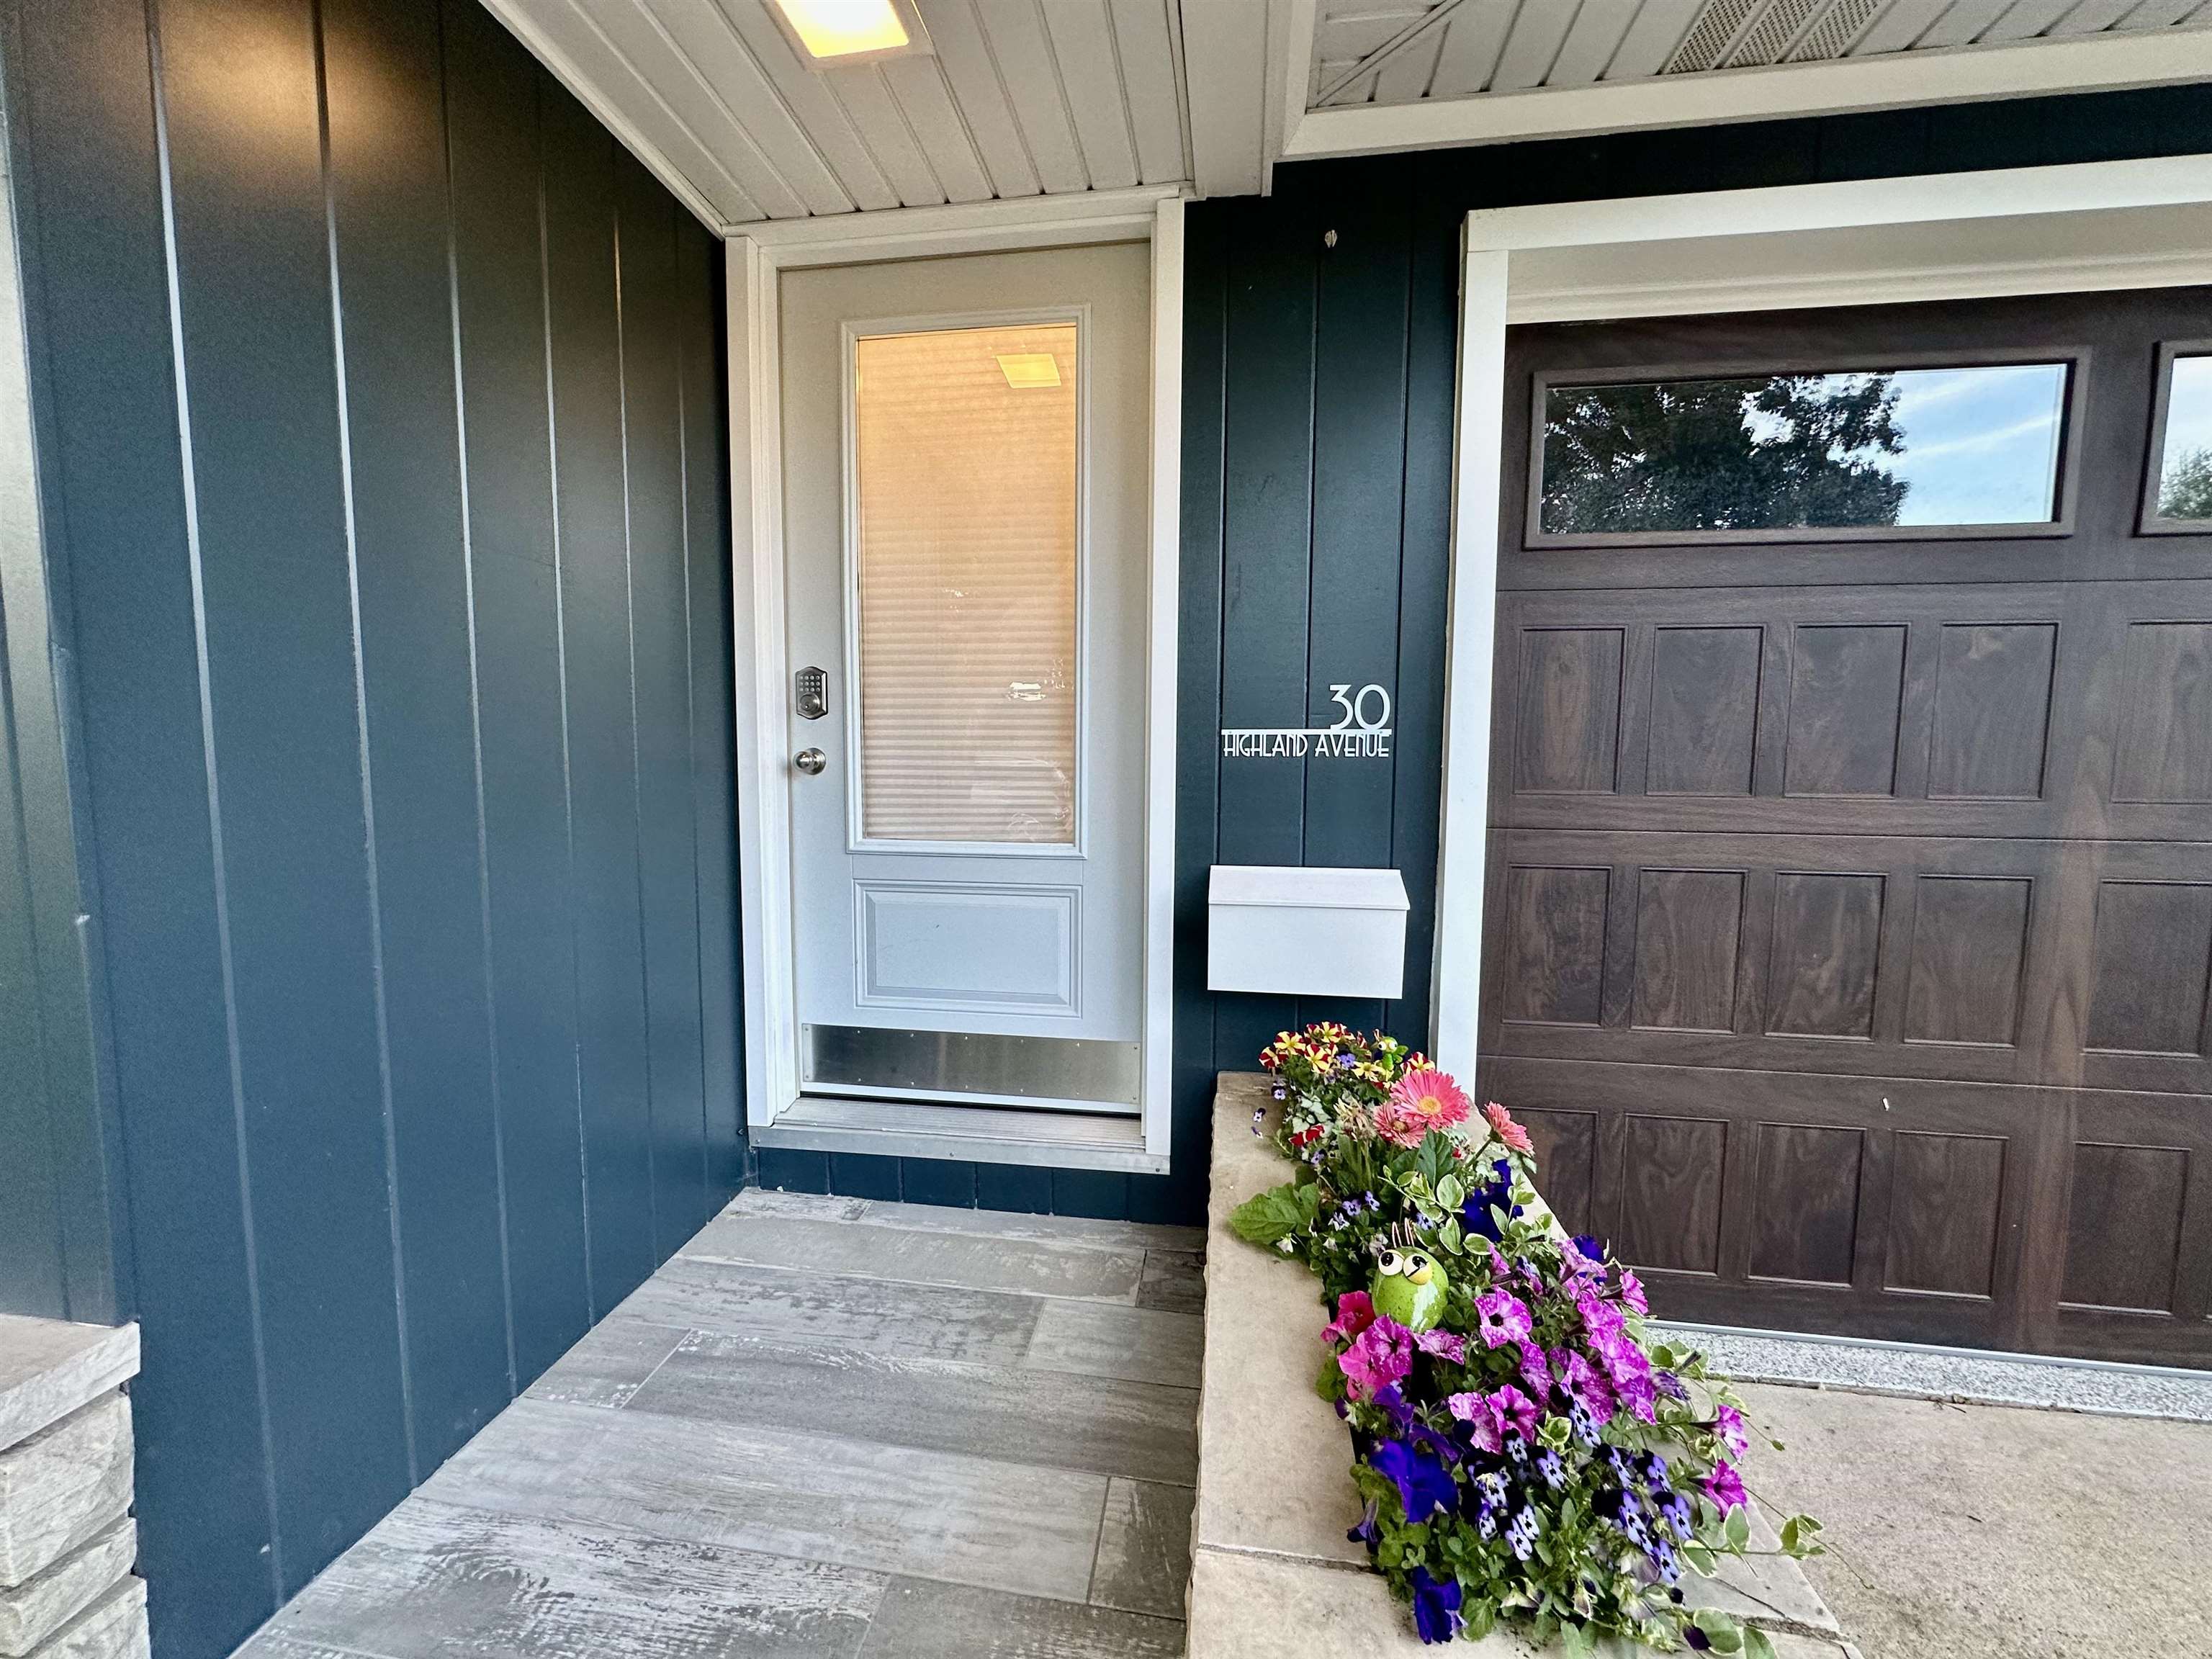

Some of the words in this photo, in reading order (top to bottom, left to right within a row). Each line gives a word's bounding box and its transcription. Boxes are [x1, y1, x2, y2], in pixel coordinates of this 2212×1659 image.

[1329, 683, 1391, 730] 30
[1223, 732, 1308, 757] HIGHLAND
[1315, 732, 1390, 757] AVENUE
